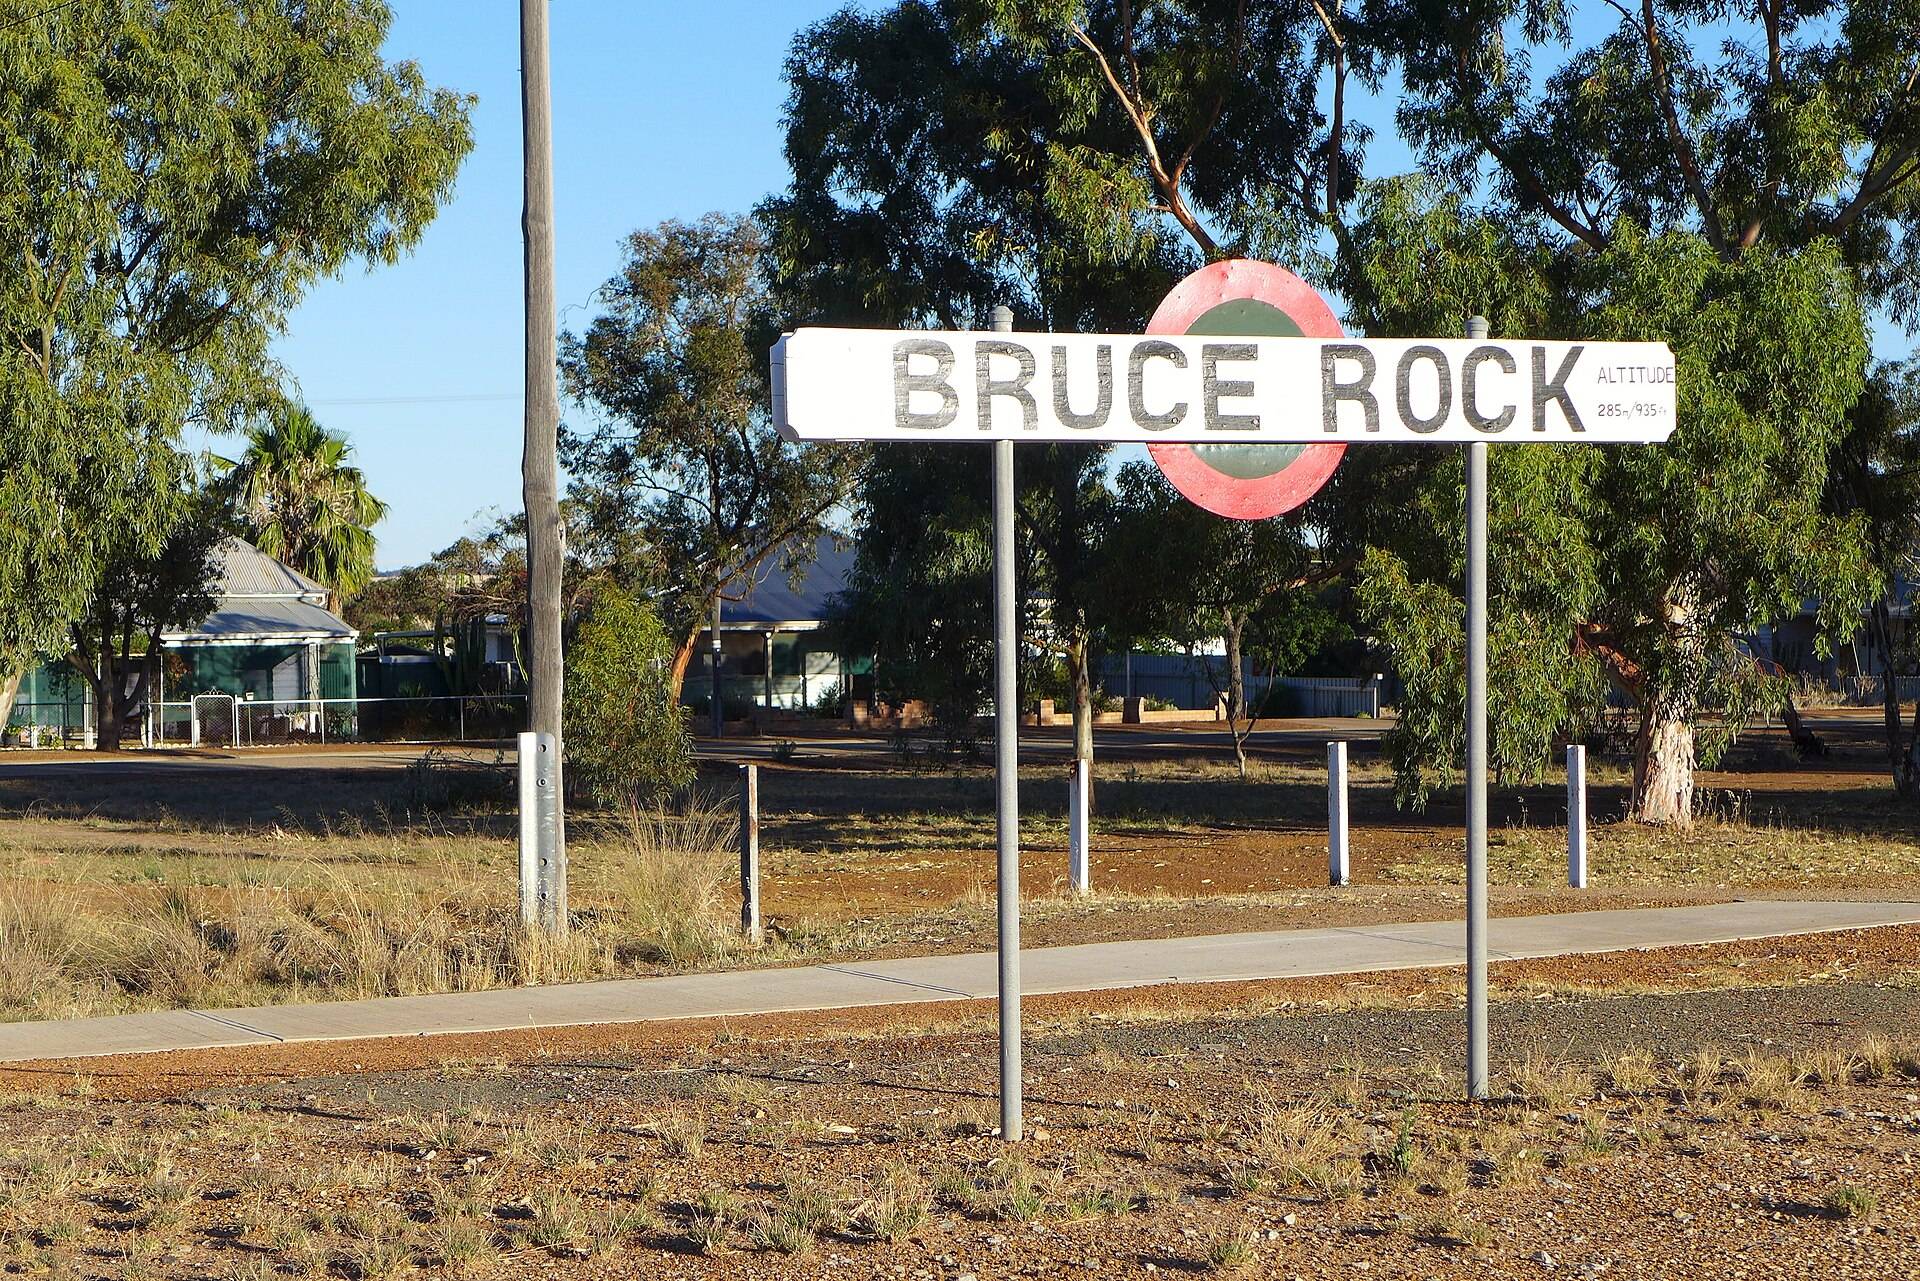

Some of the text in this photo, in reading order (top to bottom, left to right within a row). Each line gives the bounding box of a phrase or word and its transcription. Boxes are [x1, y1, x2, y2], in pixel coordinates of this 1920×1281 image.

[893, 339, 1586, 433] BRUCE ROCK
[1597, 366, 1675, 384] ALTITUDE
